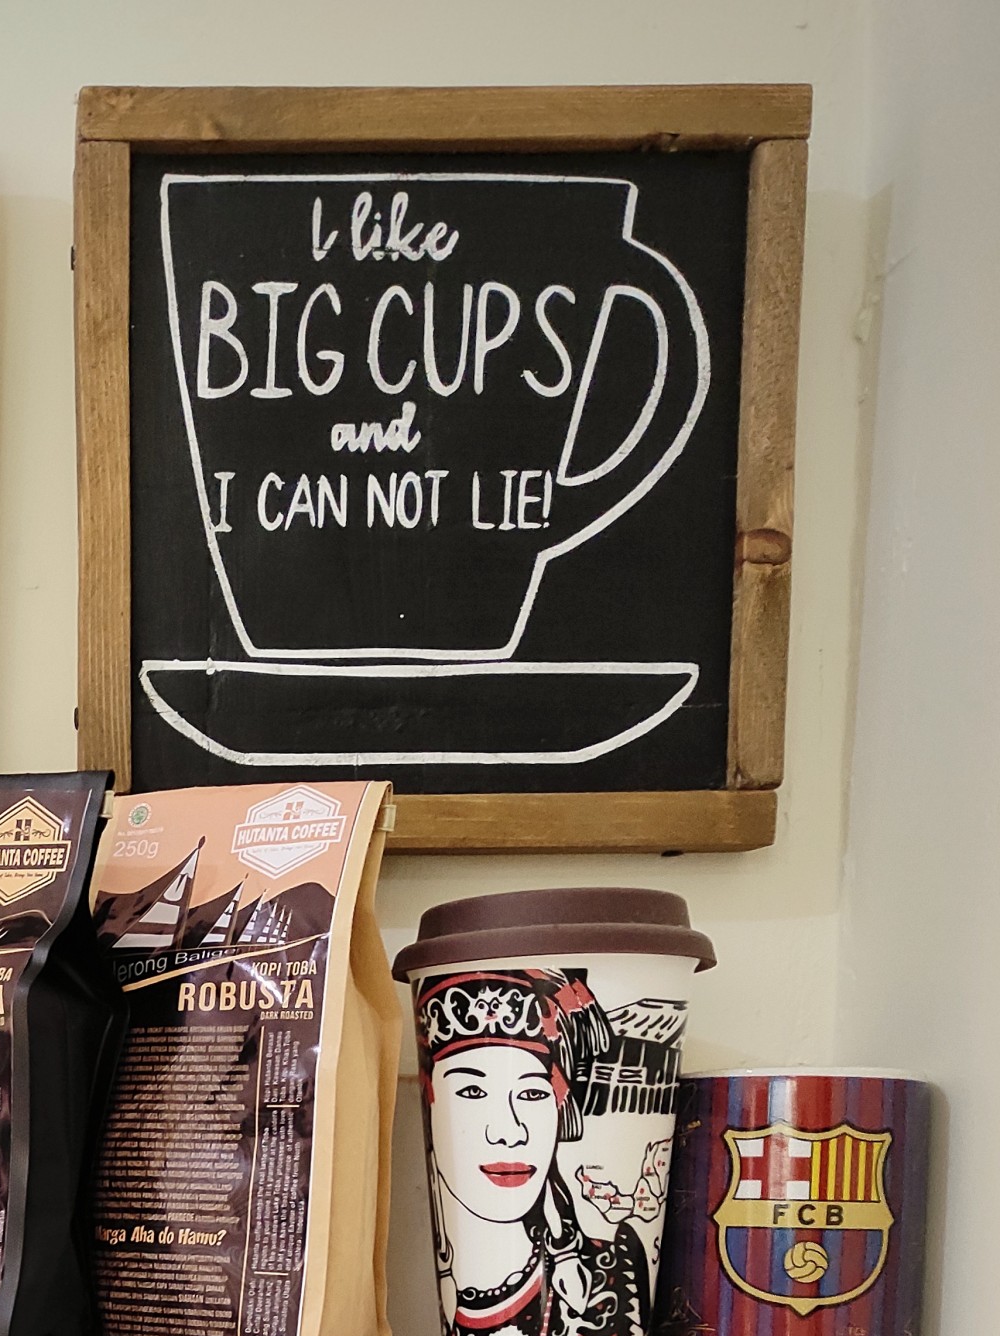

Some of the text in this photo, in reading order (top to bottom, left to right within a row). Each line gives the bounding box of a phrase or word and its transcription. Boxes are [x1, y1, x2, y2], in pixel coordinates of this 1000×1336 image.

[350, 191, 459, 262] like
[197, 281, 576, 400] BIG CUPS
[330, 401, 421, 454] and
[213, 470, 552, 533] I CAN NOT LIE!
[237, 822, 339, 845] HUTANTA COFFEE
[23, 848, 65, 866] COFFEE
[113, 839, 159, 859] 250g
[252, 960, 317, 976] KOPI TOBA
[178, 979, 314, 1012] ROBUSTA
[773, 1203, 845, 1227] FCB
[130, 1225, 155, 1244] Aha
[158, 1226, 174, 1245] do
[178, 1228, 227, 1246] Hamu?
